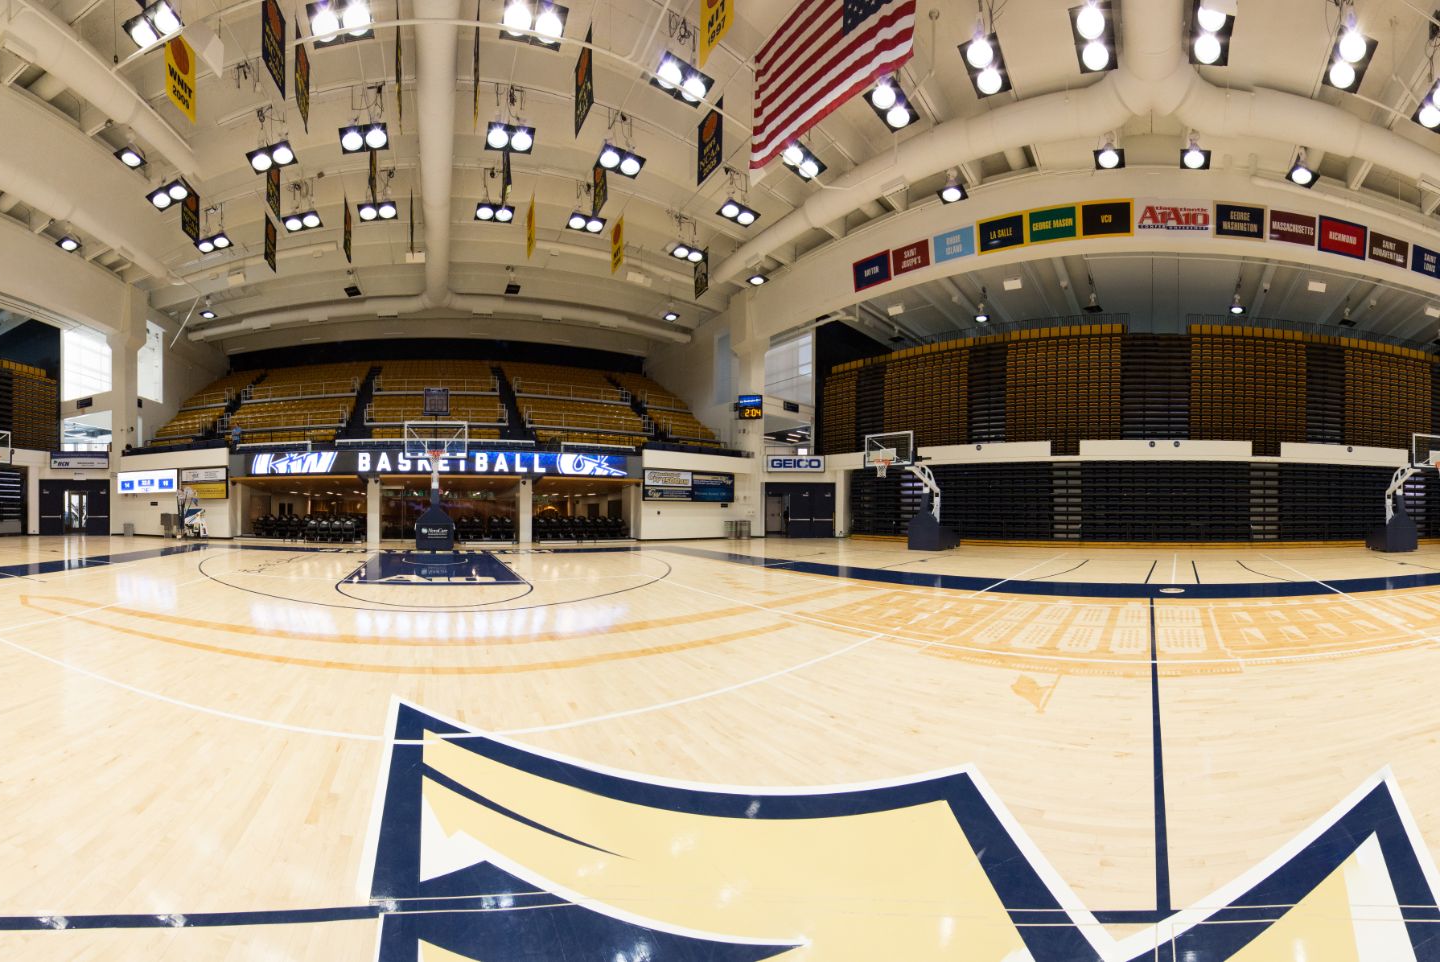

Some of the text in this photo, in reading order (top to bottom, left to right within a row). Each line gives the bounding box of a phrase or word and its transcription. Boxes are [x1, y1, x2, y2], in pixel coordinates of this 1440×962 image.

[168, 63, 193, 99] WNIT
[1100, 214, 1112, 224] VCU
[1230, 211, 1251, 221] GEORGE
[1032, 217, 1073, 232] GEORGE MASON
[1222, 220, 1258, 233] WASHINGTON
[1271, 220, 1314, 236] MASSACHUSETTS
[990, 227, 1013, 240] LA SALLE
[1328, 230, 1357, 246] RICHMOND
[945, 244, 963, 255] ISLAND
[1382, 239, 1396, 251] SAINT
[903, 248, 917, 260] SAINT
[744, 408, 761, 417] 2:04
[357, 452, 547, 473] BASKETBALL
[770, 458, 822, 469] GEICO
